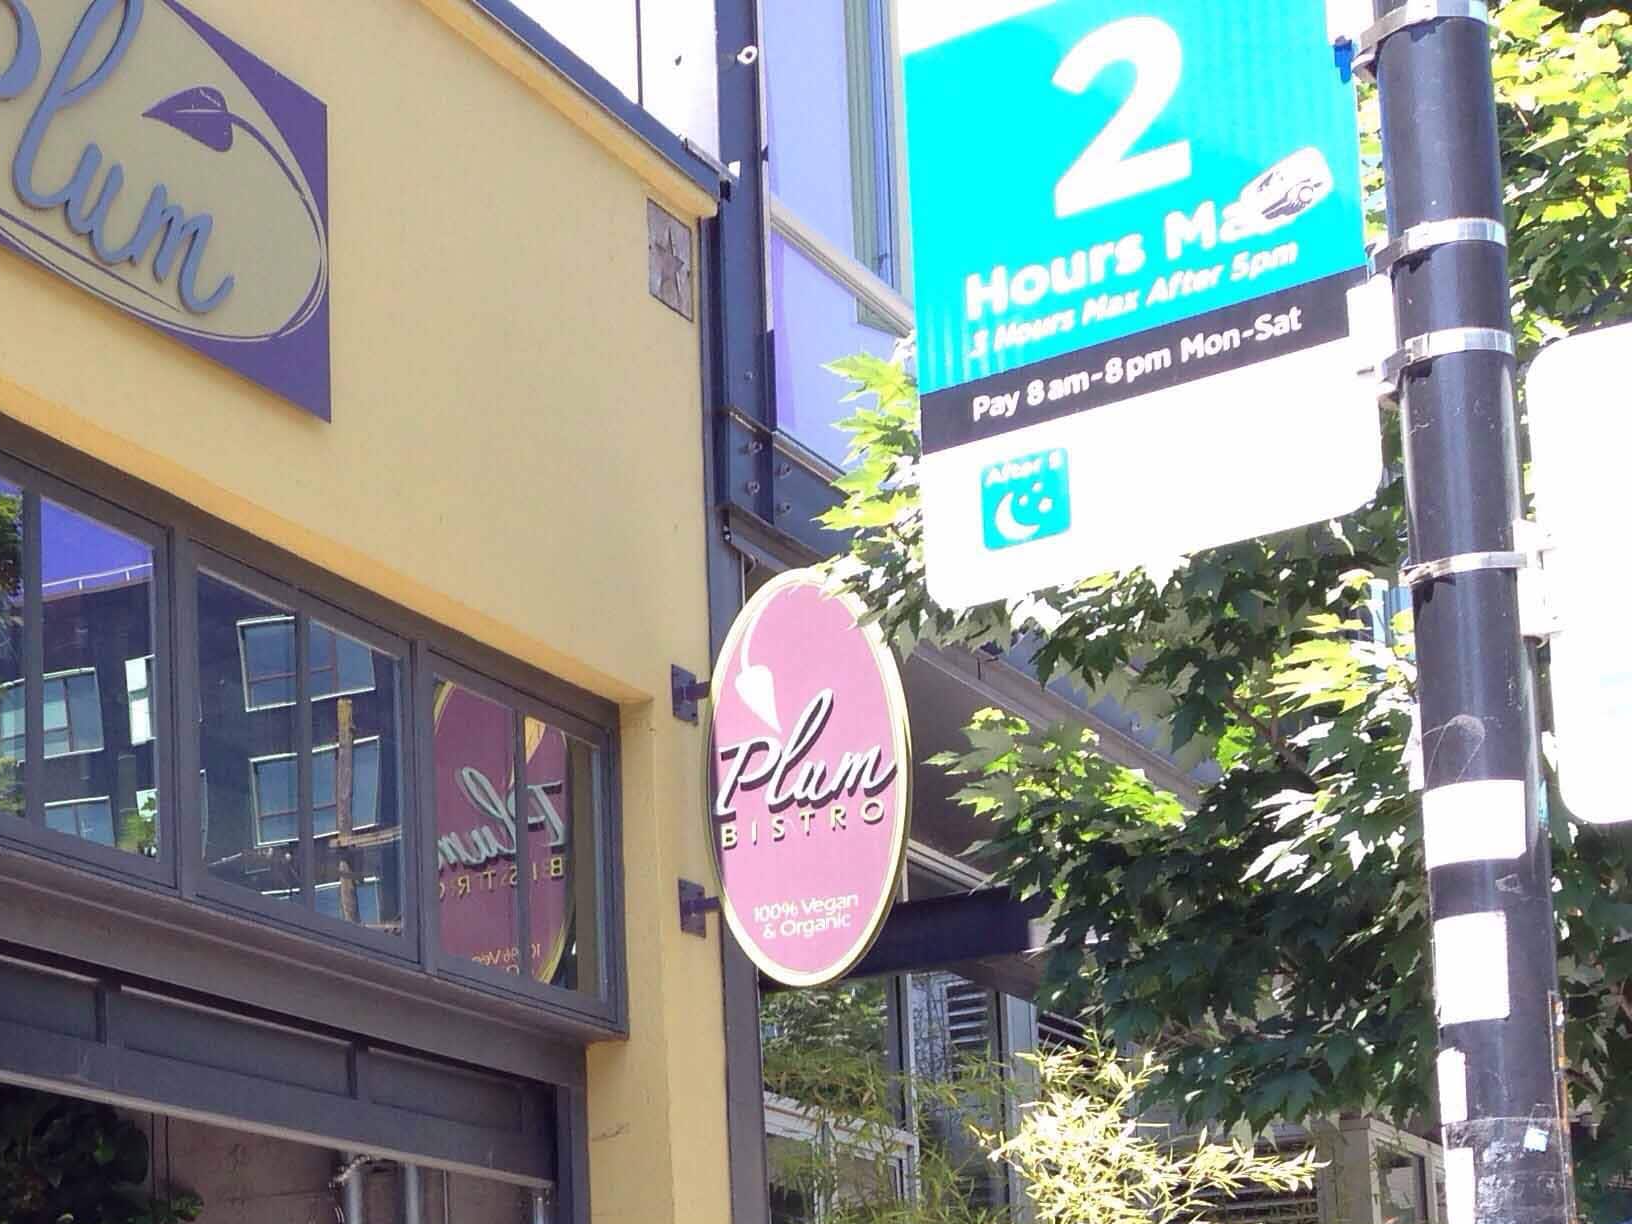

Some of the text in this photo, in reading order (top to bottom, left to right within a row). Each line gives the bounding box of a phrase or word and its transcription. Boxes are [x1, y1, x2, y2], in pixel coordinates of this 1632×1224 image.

[1051, 16, 1191, 219] 2
[965, 198, 1266, 321] Hours Ma
[994, 308, 1075, 352] Hours
[1081, 290, 1139, 325] Max
[1145, 264, 1224, 307] After
[1229, 241, 1299, 282] 5pm
[972, 389, 1021, 423] Pay
[1179, 305, 1303, 364] Mon-Sat
[715, 687, 899, 820] Plum
[720, 798, 886, 850] BISTRO
[752, 893, 859, 924] 100% Vegan
[762, 911, 852, 940] & Organic
